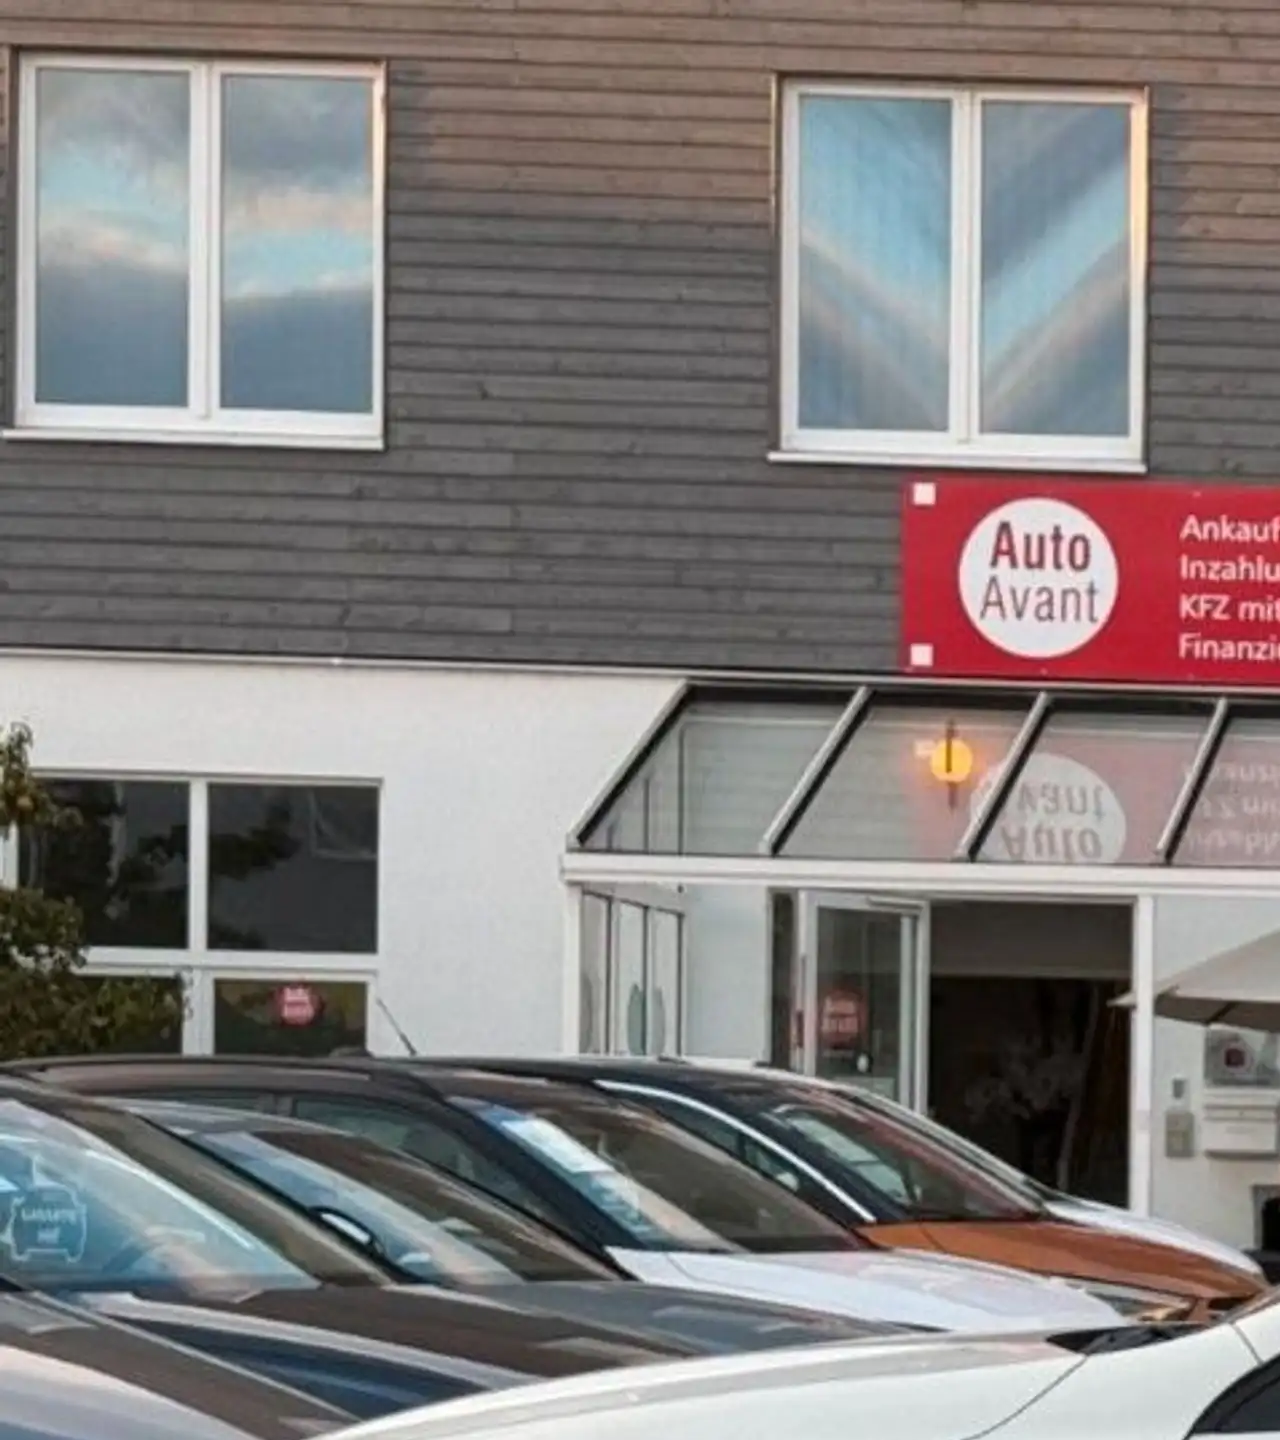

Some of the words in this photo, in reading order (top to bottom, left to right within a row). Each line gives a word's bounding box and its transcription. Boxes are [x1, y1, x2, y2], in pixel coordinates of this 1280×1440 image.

[989, 520, 1091, 572] Auto
[979, 573, 1099, 624] Avant
[1180, 592, 1231, 621] KFZ
